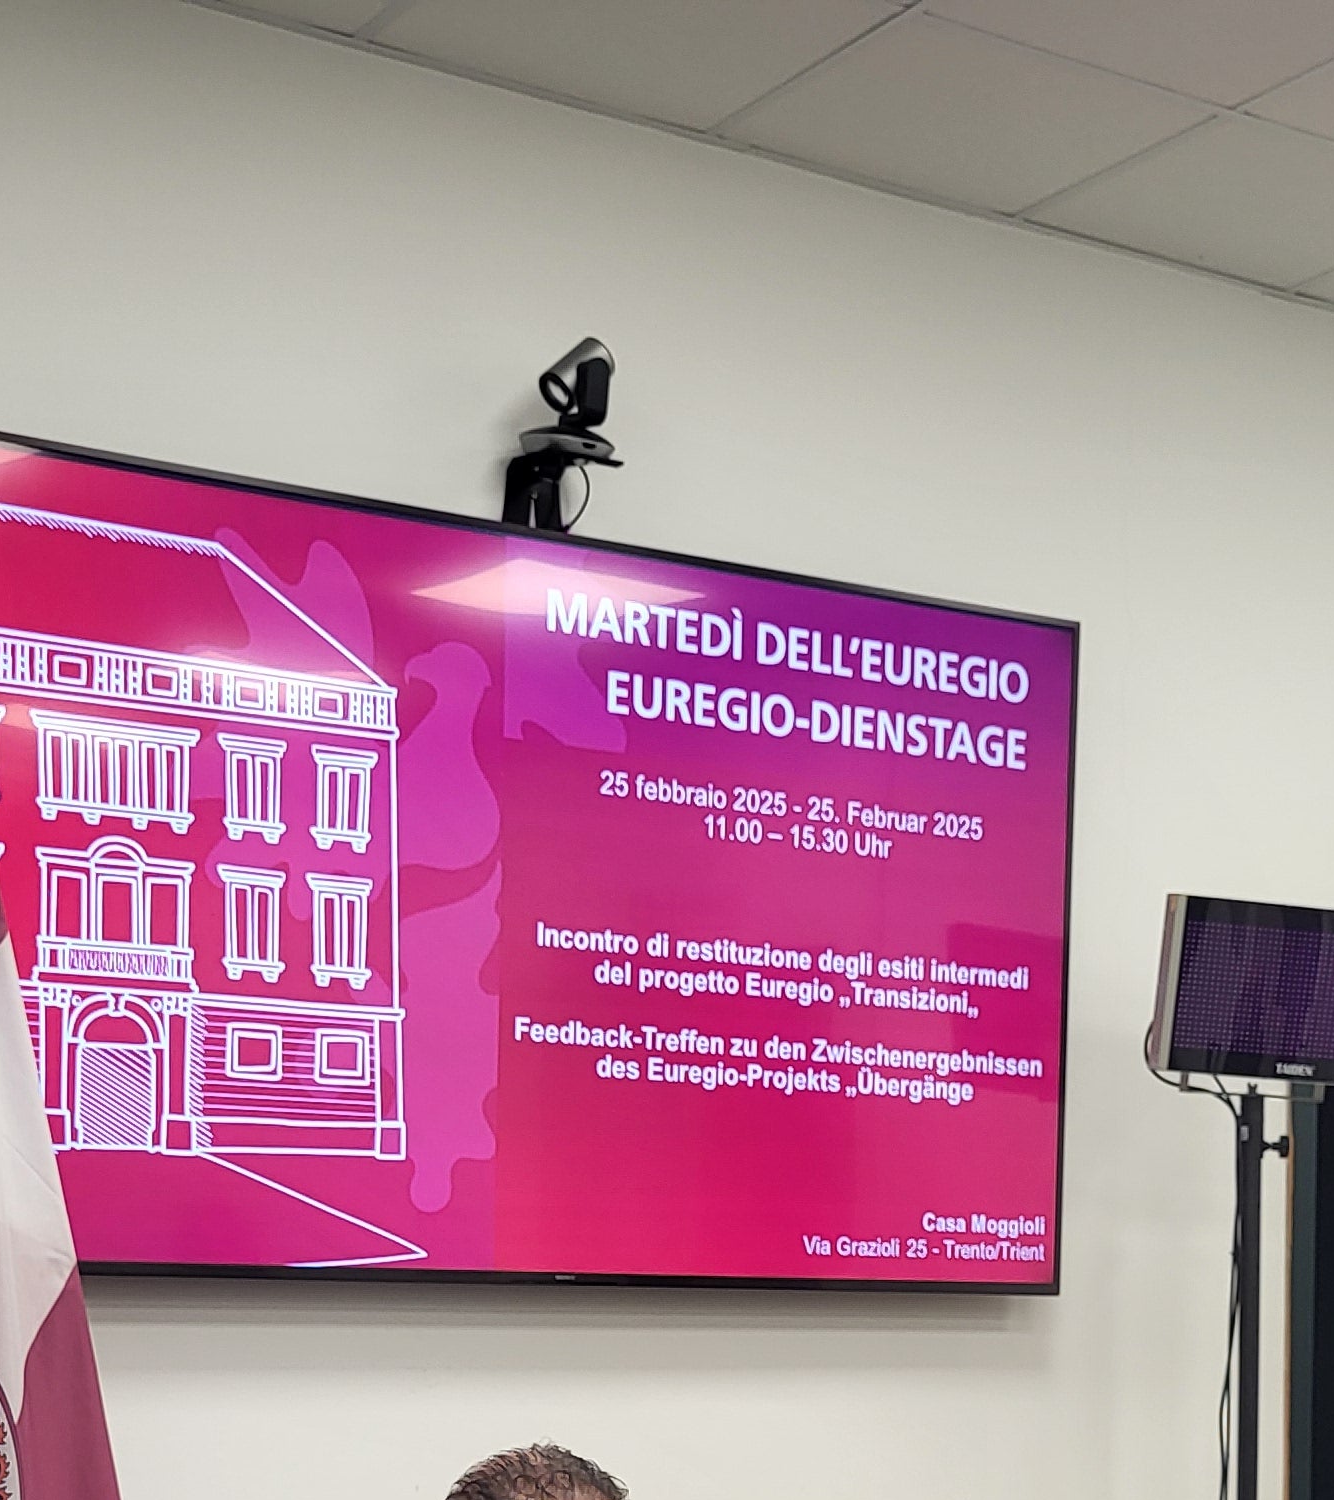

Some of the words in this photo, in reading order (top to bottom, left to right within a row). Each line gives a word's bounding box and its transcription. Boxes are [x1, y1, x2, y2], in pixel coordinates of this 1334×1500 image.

[546, 588, 743, 660] MARTEDÌ
[756, 623, 1029, 704] DELL'EUREGIO
[605, 670, 1027, 771] EUREGIO-DIENSTAGE
[599, 769, 629, 798] 25
[635, 773, 727, 810] febbraio
[732, 786, 787, 817] 2025
[807, 796, 840, 824] 25.
[847, 801, 928, 836] Februar
[933, 811, 984, 841] 2025
[704, 814, 763, 844] 11.00
[790, 825, 849, 854] 15.30
[854, 829, 893, 859] Uhr
[536, 921, 639, 955] Incontro
[646, 932, 669, 958] di
[677, 938, 812, 972] restituzione
[817, 948, 873, 979] degli
[877, 955, 925, 981] esiti
[930, 960, 1029, 990] intermedi
[594, 960, 632, 986] del
[638, 968, 740, 997] progetto
[745, 976, 834, 1007] Euregio
[514, 1016, 725, 1058] Feedback-Treffen
[729, 1037, 758, 1058] zu
[764, 1035, 807, 1061] den
[811, 1037, 1043, 1078] Zwischenergebnissen
[596, 1054, 640, 1080] des
[647, 1059, 842, 1096] Euregio-Projekts
[803, 1235, 831, 1256] Via
[836, 1235, 900, 1258] Grazioli
[906, 1238, 928, 1259] 25
[943, 1239, 1045, 1262] Trento/Trient
[922, 1212, 967, 1233] Casa
[971, 1213, 1046, 1239] Moggioli
